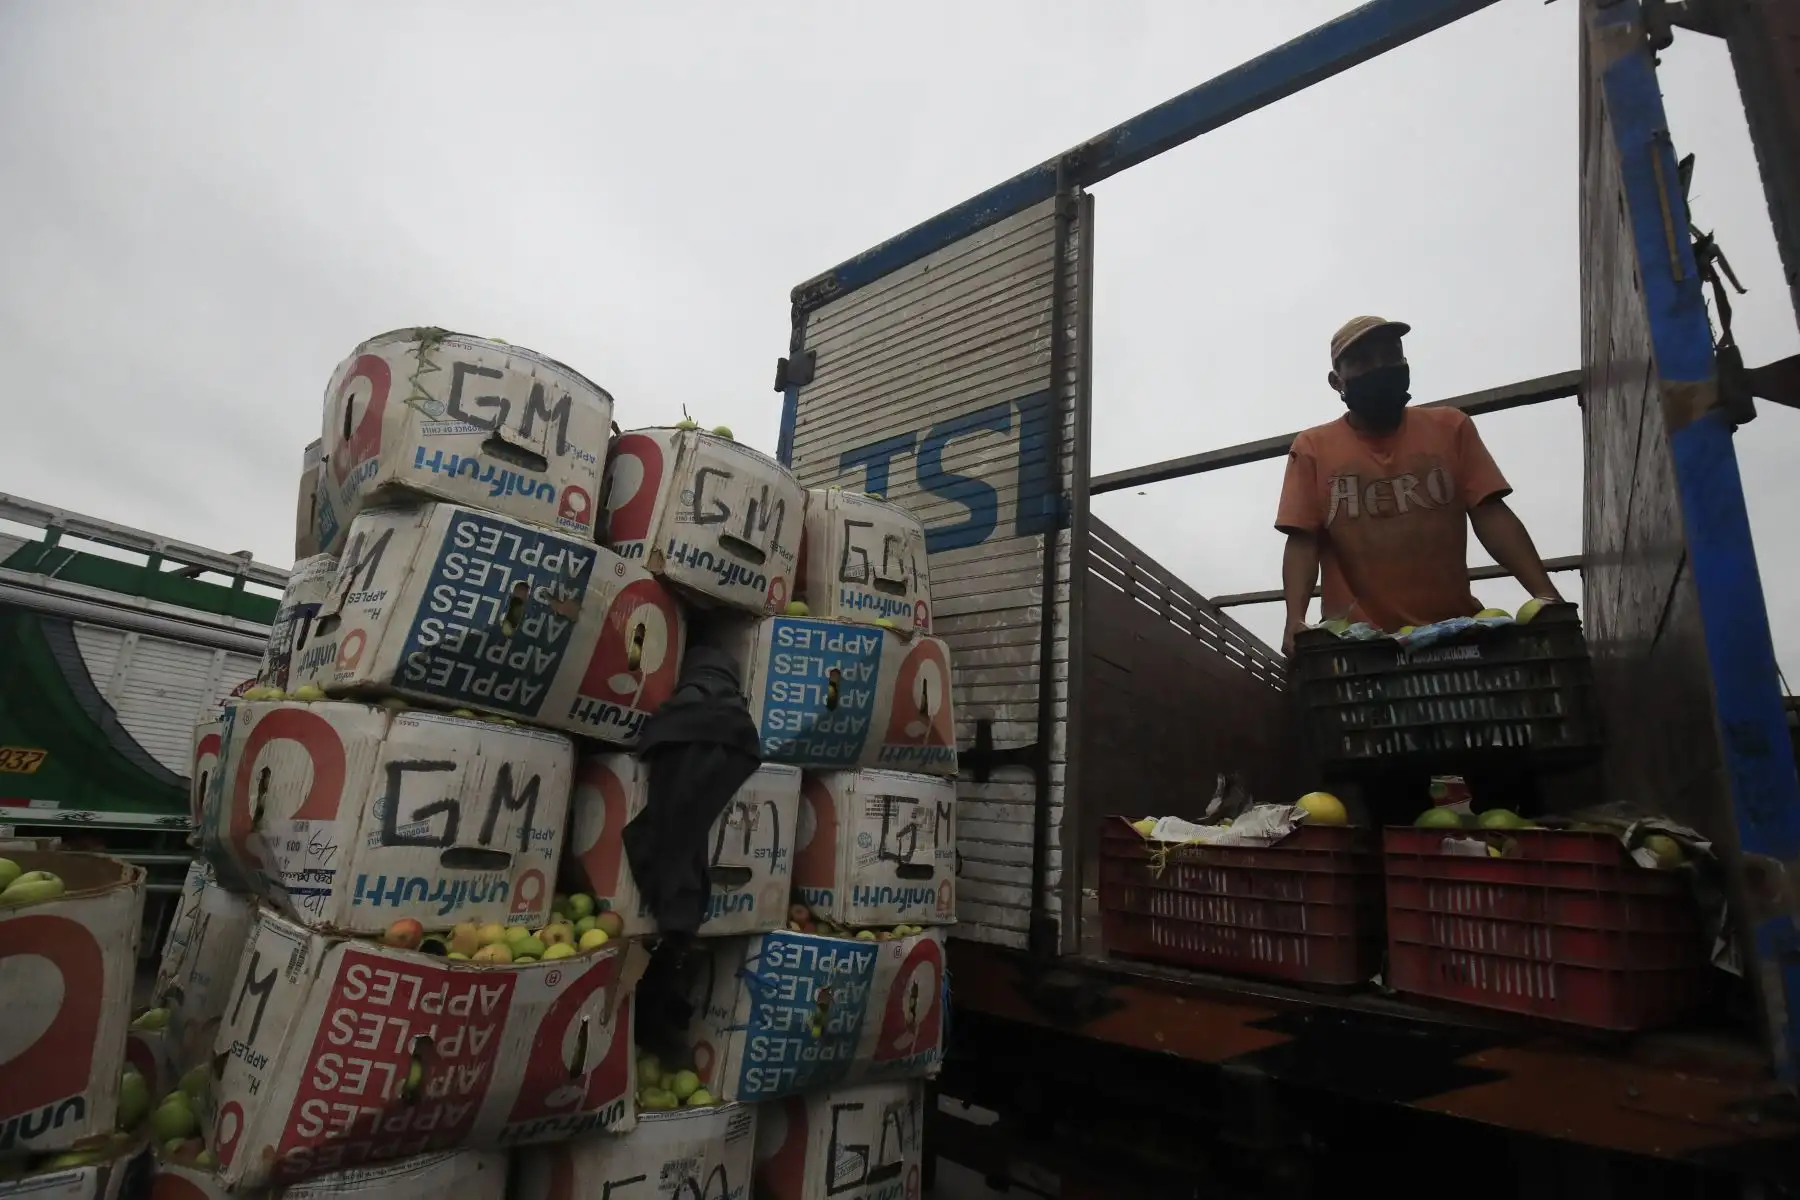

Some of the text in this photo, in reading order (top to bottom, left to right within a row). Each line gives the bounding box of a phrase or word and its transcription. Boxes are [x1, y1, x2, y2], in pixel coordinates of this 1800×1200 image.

[447, 361, 572, 457] GM
[420, 426, 441, 435] CHILE
[453, 424, 483, 435] RODUCE
[414, 445, 555, 505] unifrutti
[555, 516, 589, 532] unifrutti
[453, 519, 591, 579] APPLES
[666, 537, 768, 594] unifrutti
[347, 589, 389, 605] APPLES
[430, 584, 570, 643] APLES
[839, 588, 912, 619] unifrutti
[417, 618, 558, 674] APPLES
[776, 626, 880, 657] APPLES
[405, 650, 544, 708] APPLES
[770, 680, 871, 710] APLES
[567, 694, 643, 741] frutti
[767, 708, 867, 736] APPLES
[763, 734, 859, 758] APPLES
[383, 759, 541, 854] GM
[352, 873, 511, 917] unifrutti
[851, 882, 936, 911] unifrutti
[767, 940, 873, 975] APPLES
[231, 951, 278, 1046] M
[342, 963, 506, 1017] APPLES
[762, 972, 869, 1004] APLES
[758, 1002, 862, 1034] APLES
[229, 1039, 269, 1072] APPLES
[749, 1034, 855, 1064] APPLES
[312, 1052, 484, 1100] APLES
[296, 1097, 475, 1141] APPLES
[280, 1132, 430, 1177] PPLES
